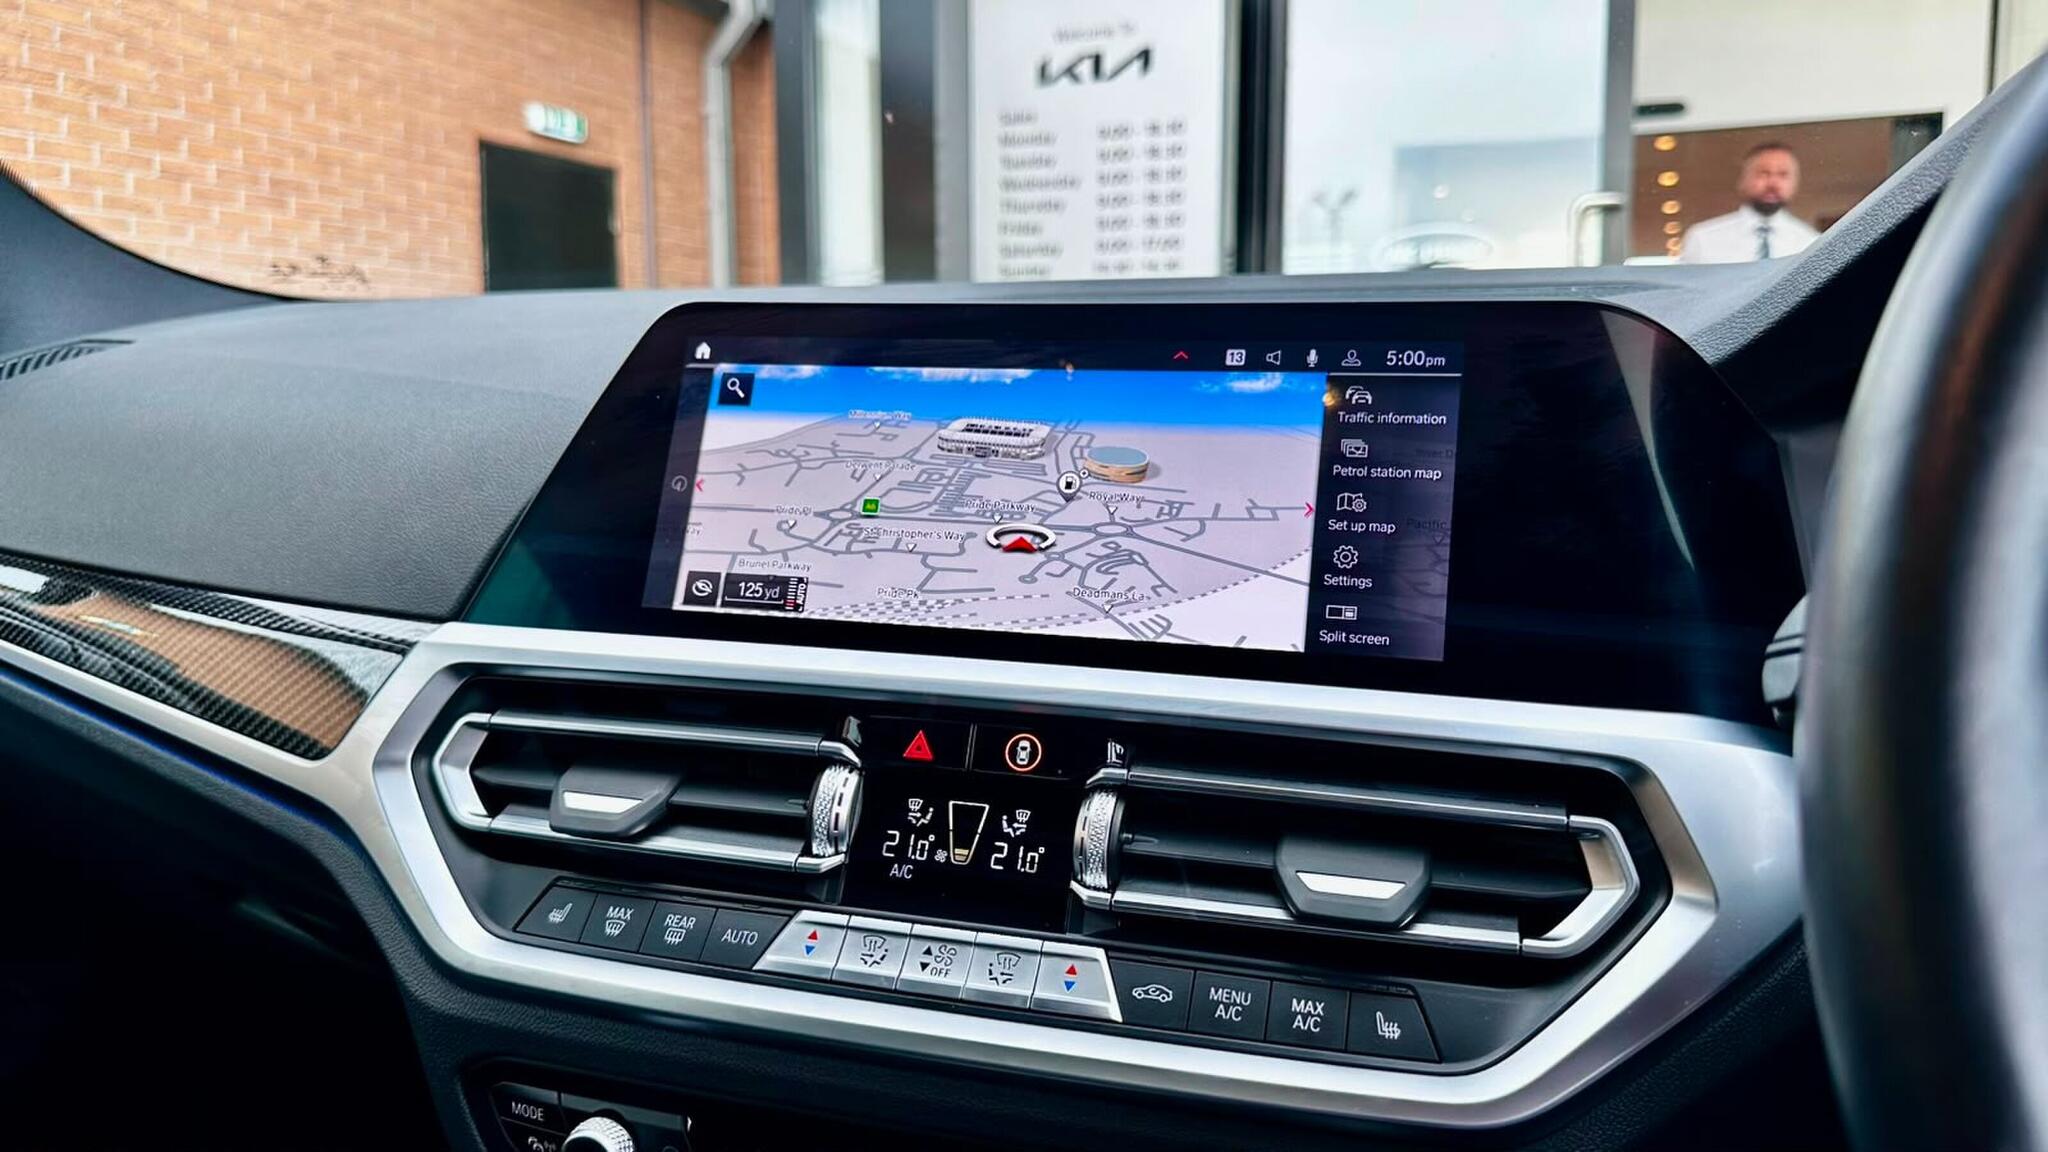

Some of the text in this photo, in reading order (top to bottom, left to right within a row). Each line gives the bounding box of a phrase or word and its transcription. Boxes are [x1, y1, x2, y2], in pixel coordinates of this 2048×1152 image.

[1038, 45, 1152, 86] KIA
[1228, 351, 1245, 365] 13
[1338, 412, 1447, 425] Traffic information
[1333, 465, 1442, 482] Petrol station map
[1089, 491, 1117, 502] Royal
[965, 500, 1036, 513] Pride Parkway
[1328, 519, 1396, 535] Set up map
[1406, 518, 1447, 529] Pacific
[876, 528, 941, 540] Christopher's
[943, 531, 965, 542] Way
[739, 559, 812, 572] Brunel Parkway
[1324, 574, 1373, 589] Settings
[738, 581, 780, 600] 125 yd
[877, 587, 904, 599] Pride
[1073, 586, 1129, 600] Deadmans
[1319, 630, 1390, 645] Split screen
[890, 864, 914, 879] A/C
[606, 905, 634, 921] MAX
[664, 914, 696, 930] REAR
[721, 928, 758, 946] AUTO
[930, 966, 952, 979] OFF
[1209, 986, 1252, 1006] MENU
[1215, 1004, 1242, 1022] A/C
[1291, 998, 1325, 1016] MAX
[1293, 1016, 1321, 1033] A/C
[511, 1101, 545, 1121] MODE
